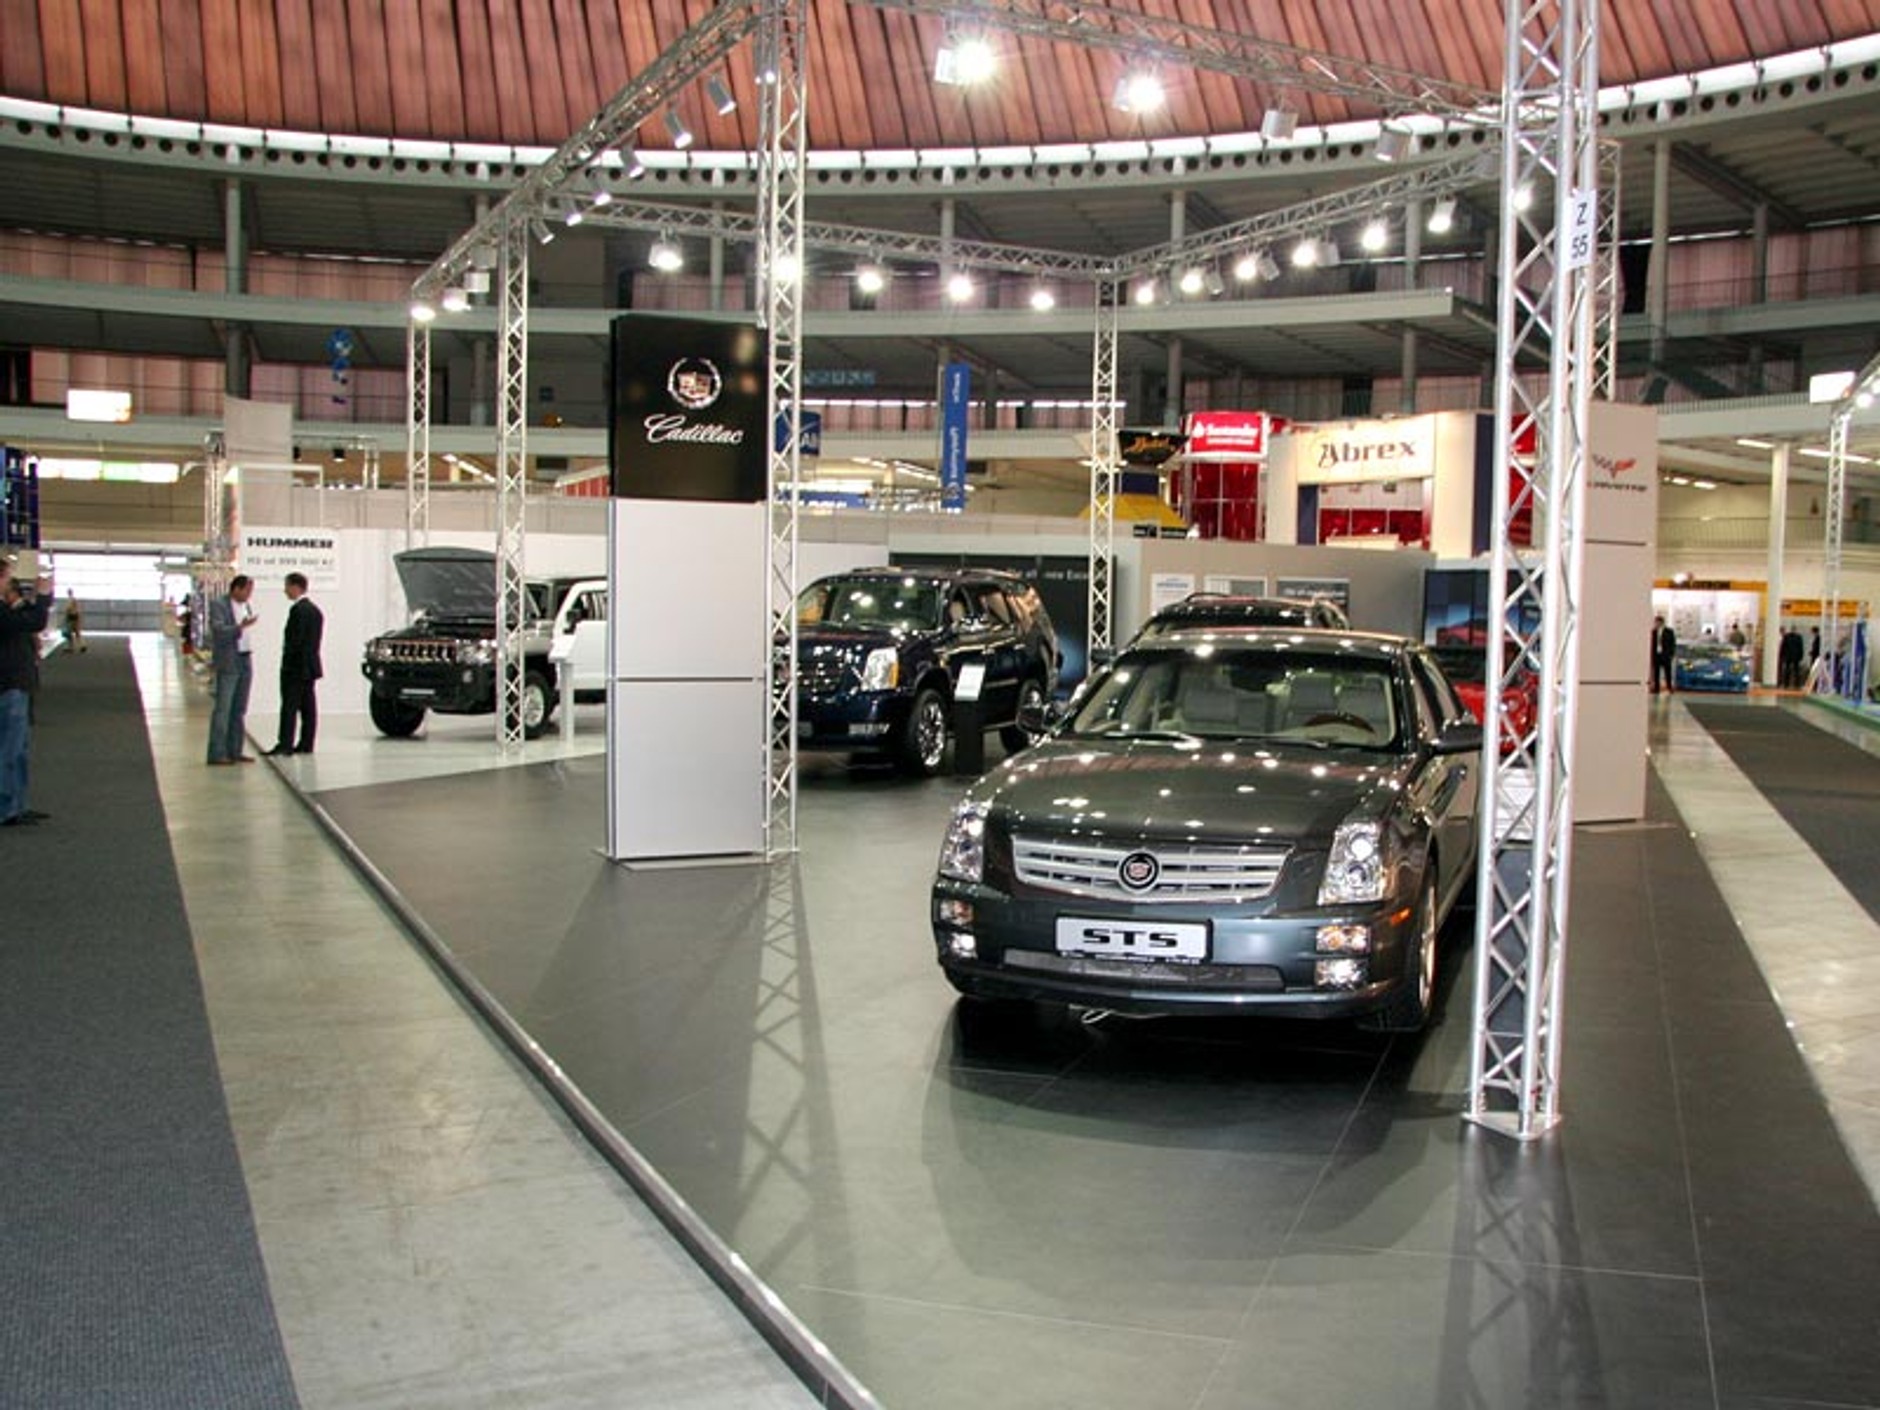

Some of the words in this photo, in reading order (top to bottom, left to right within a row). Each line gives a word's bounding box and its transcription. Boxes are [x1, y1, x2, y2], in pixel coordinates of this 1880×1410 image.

[1577, 202, 1587, 226] Z
[1572, 234, 1587, 259] 55
[644, 414, 743, 444] Cadillac
[1318, 441, 1417, 468] Abrex
[247, 537, 333, 549] HUMMER
[1083, 928, 1178, 948] STS
